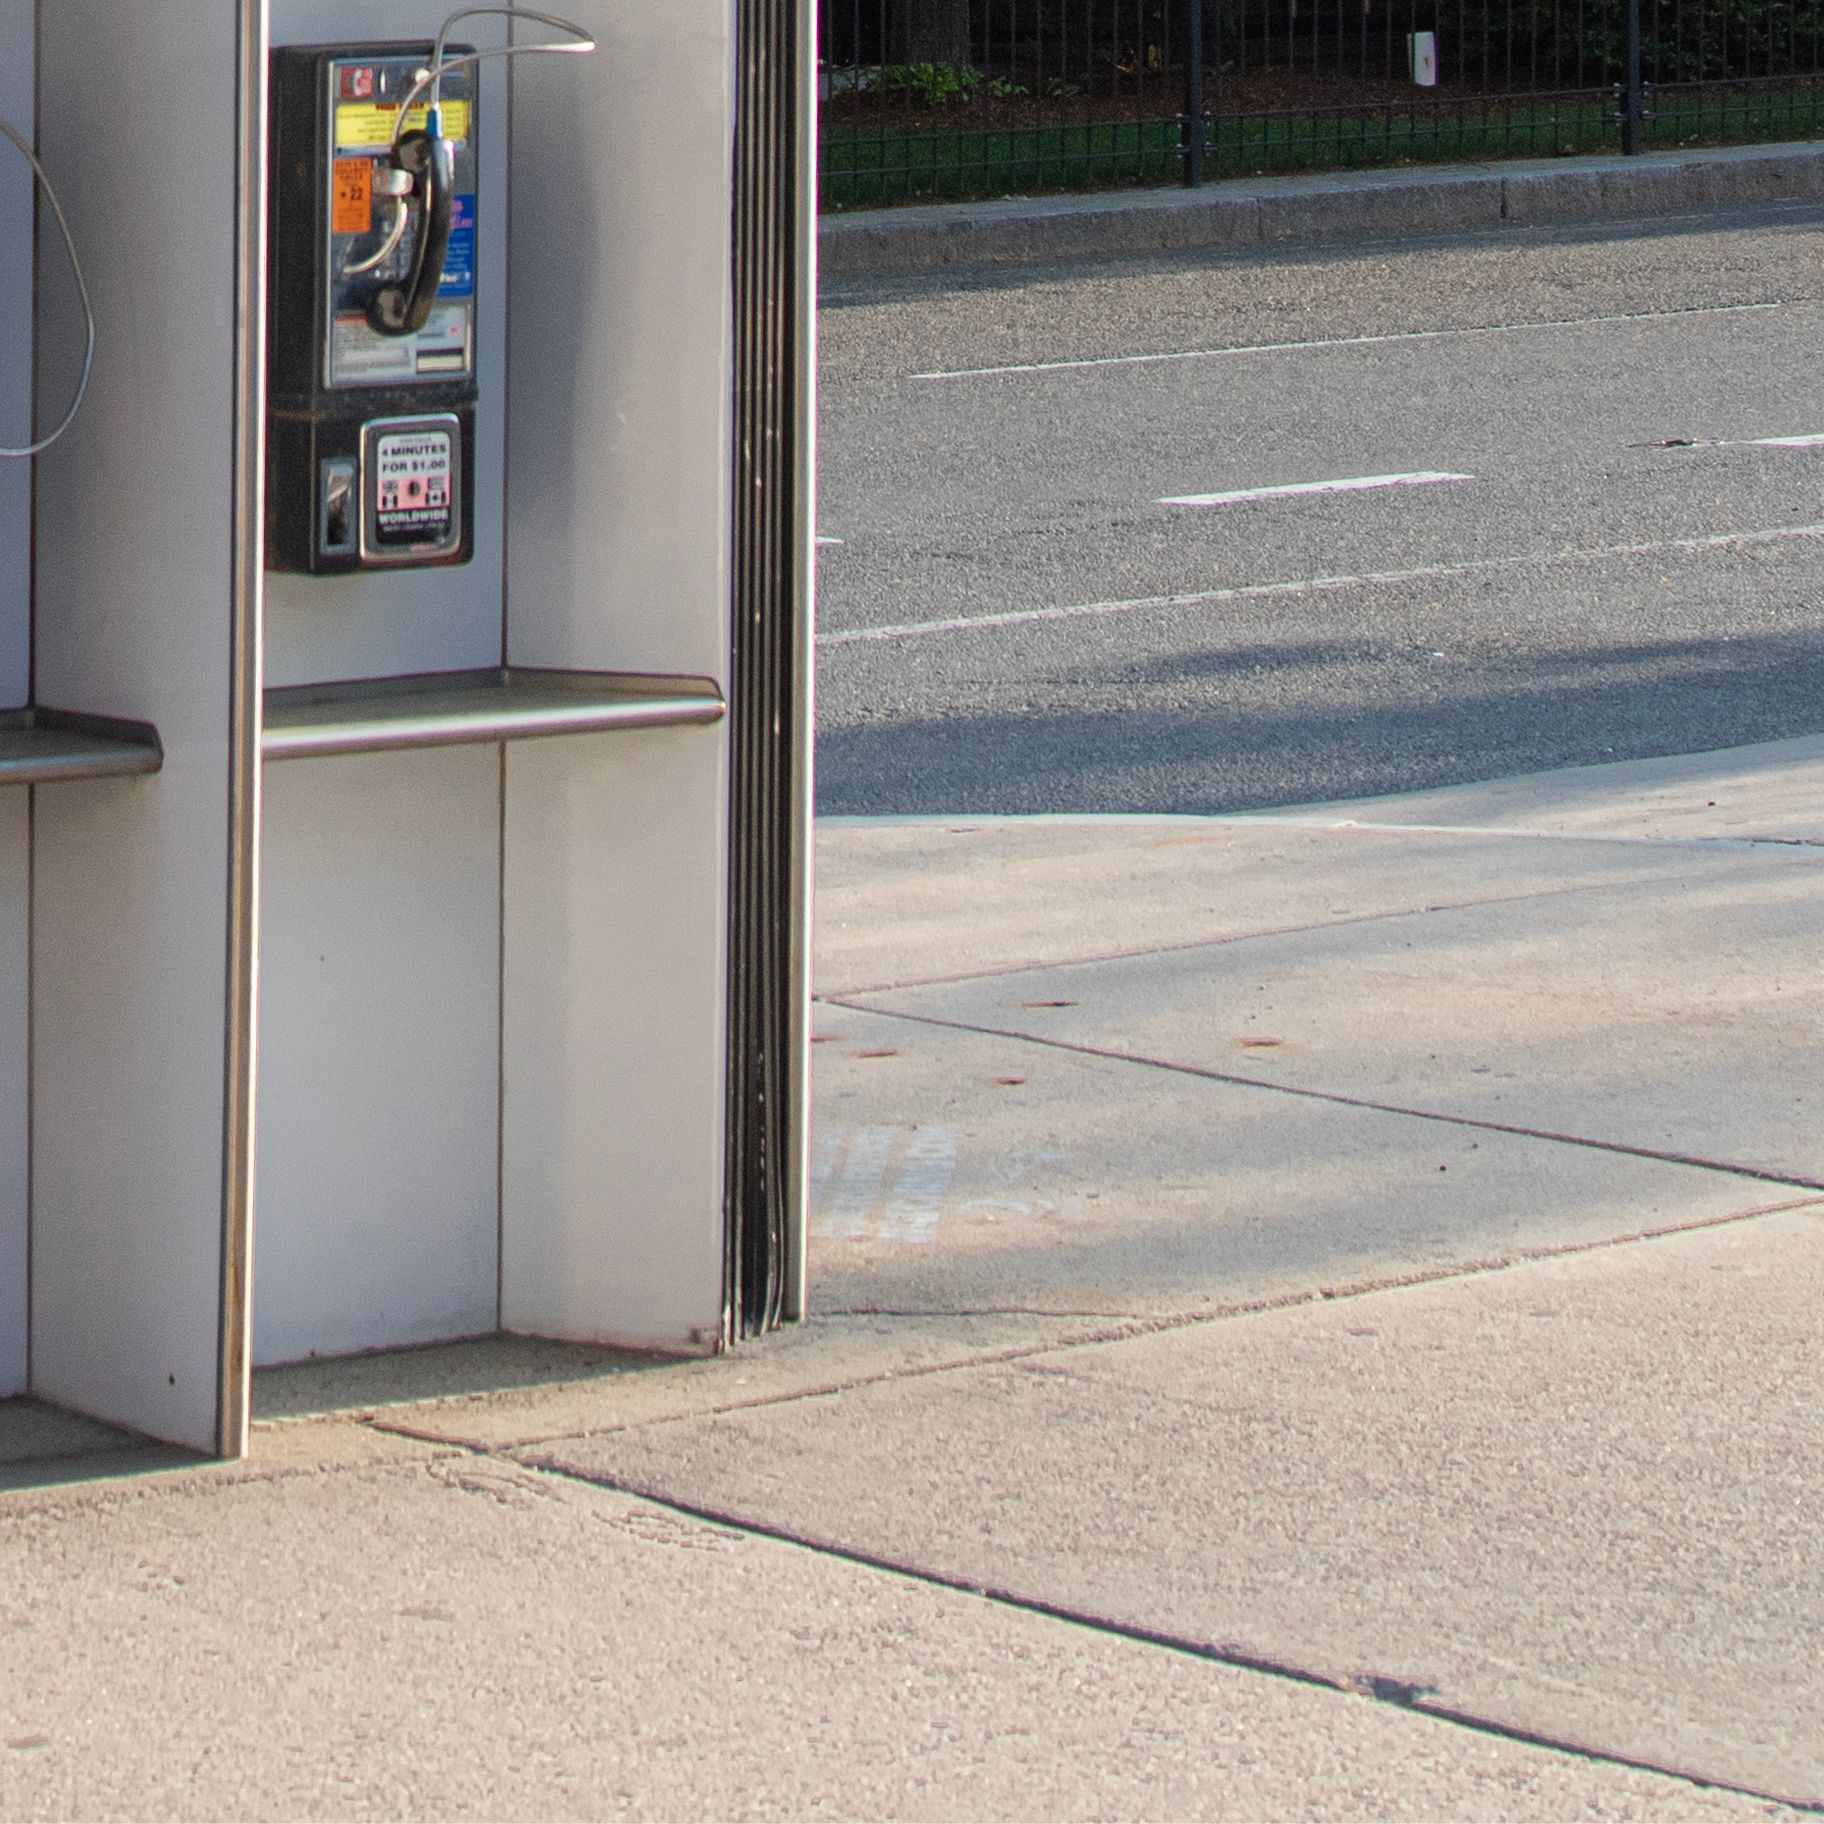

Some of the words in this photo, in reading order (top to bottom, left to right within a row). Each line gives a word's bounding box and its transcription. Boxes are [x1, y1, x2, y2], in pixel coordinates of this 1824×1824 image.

[391, 444, 447, 455] MINUTES
[382, 461, 408, 472] FOR
[412, 459, 446, 471] $1.00
[379, 508, 448, 524] WORLDWIDE
